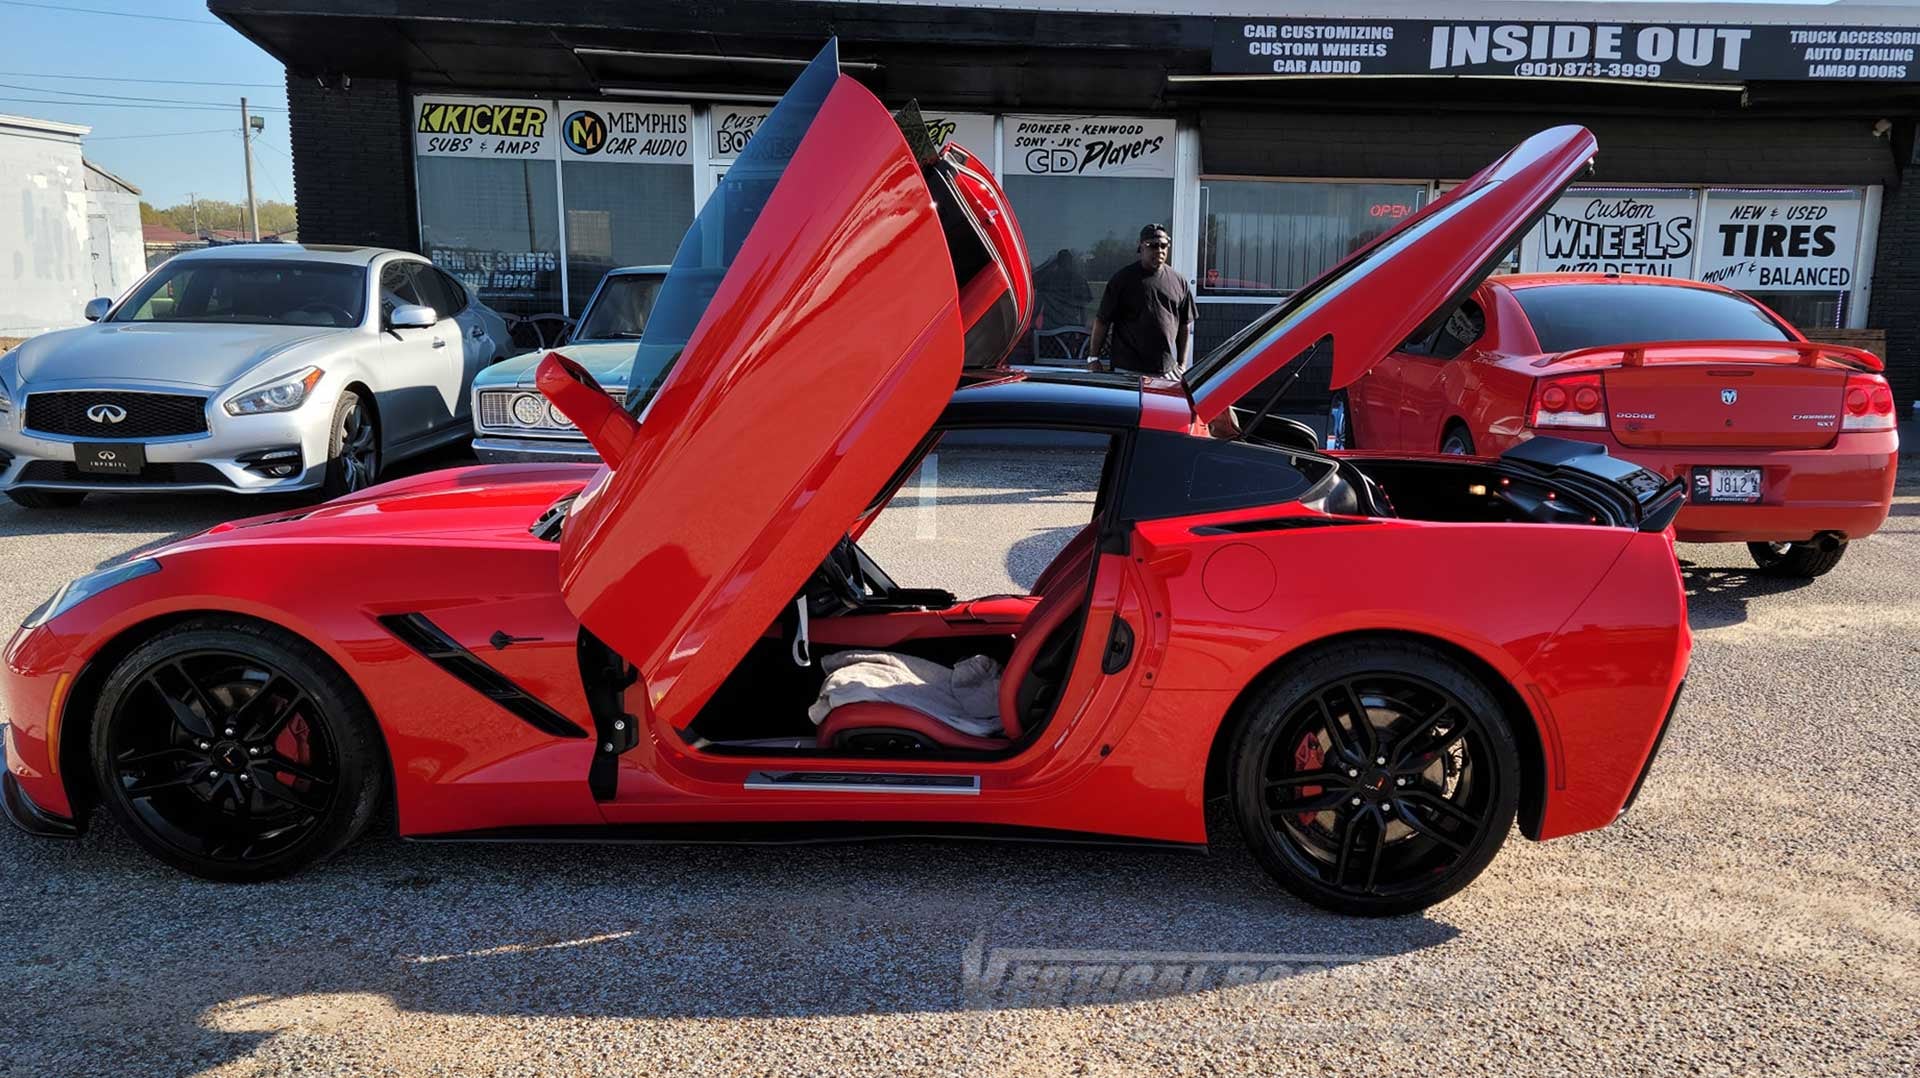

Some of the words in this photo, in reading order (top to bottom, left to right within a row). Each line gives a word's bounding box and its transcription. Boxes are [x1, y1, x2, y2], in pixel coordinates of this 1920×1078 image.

[1243, 24, 1277, 39] CAR
[1280, 25, 1394, 40] CUSTOMIZING
[1790, 30, 1838, 44] TRUCK
[1249, 42, 1319, 55] CUSTOM
[1322, 43, 1388, 57] WHEELS
[1429, 24, 1624, 70] INSIDE
[1636, 26, 1752, 71] OUT
[1804, 47, 1842, 60] AUTO
[1844, 48, 1914, 62] DETAILING
[1273, 59, 1307, 73] CAR
[1309, 60, 1362, 73] AUDIO
[1513, 62, 1661, 78] (901)873-3999
[1808, 64, 1857, 77] LAMBO
[1858, 65, 1907, 78] DOORS
[607, 111, 687, 134] MEMPHIS
[1017, 122, 1072, 134] PIONEER
[1081, 124, 1144, 135] KENWOOD
[427, 136, 473, 152] SUBS
[494, 140, 540, 154] AMPS
[605, 137, 638, 154] CAR
[639, 138, 688, 157] AUDIO
[1014, 136, 1047, 148] SONY
[1057, 137, 1082, 148] JVC
[1025, 148, 1078, 174] CD
[1078, 136, 1165, 175] Players
[1369, 204, 1412, 218] OPEN
[1584, 198, 1656, 220] Custom
[1730, 205, 1767, 220] NEW
[1786, 206, 1828, 220] USED
[1543, 212, 1694, 260] WHEELS
[1718, 224, 1837, 258] TIRES
[495, 251, 556, 272] STARTS
[1701, 261, 1749, 284] MOUNT
[1759, 267, 1850, 286] BALANCED
[1616, 411, 1656, 420] DODGE
[1716, 476, 1747, 493] J812
